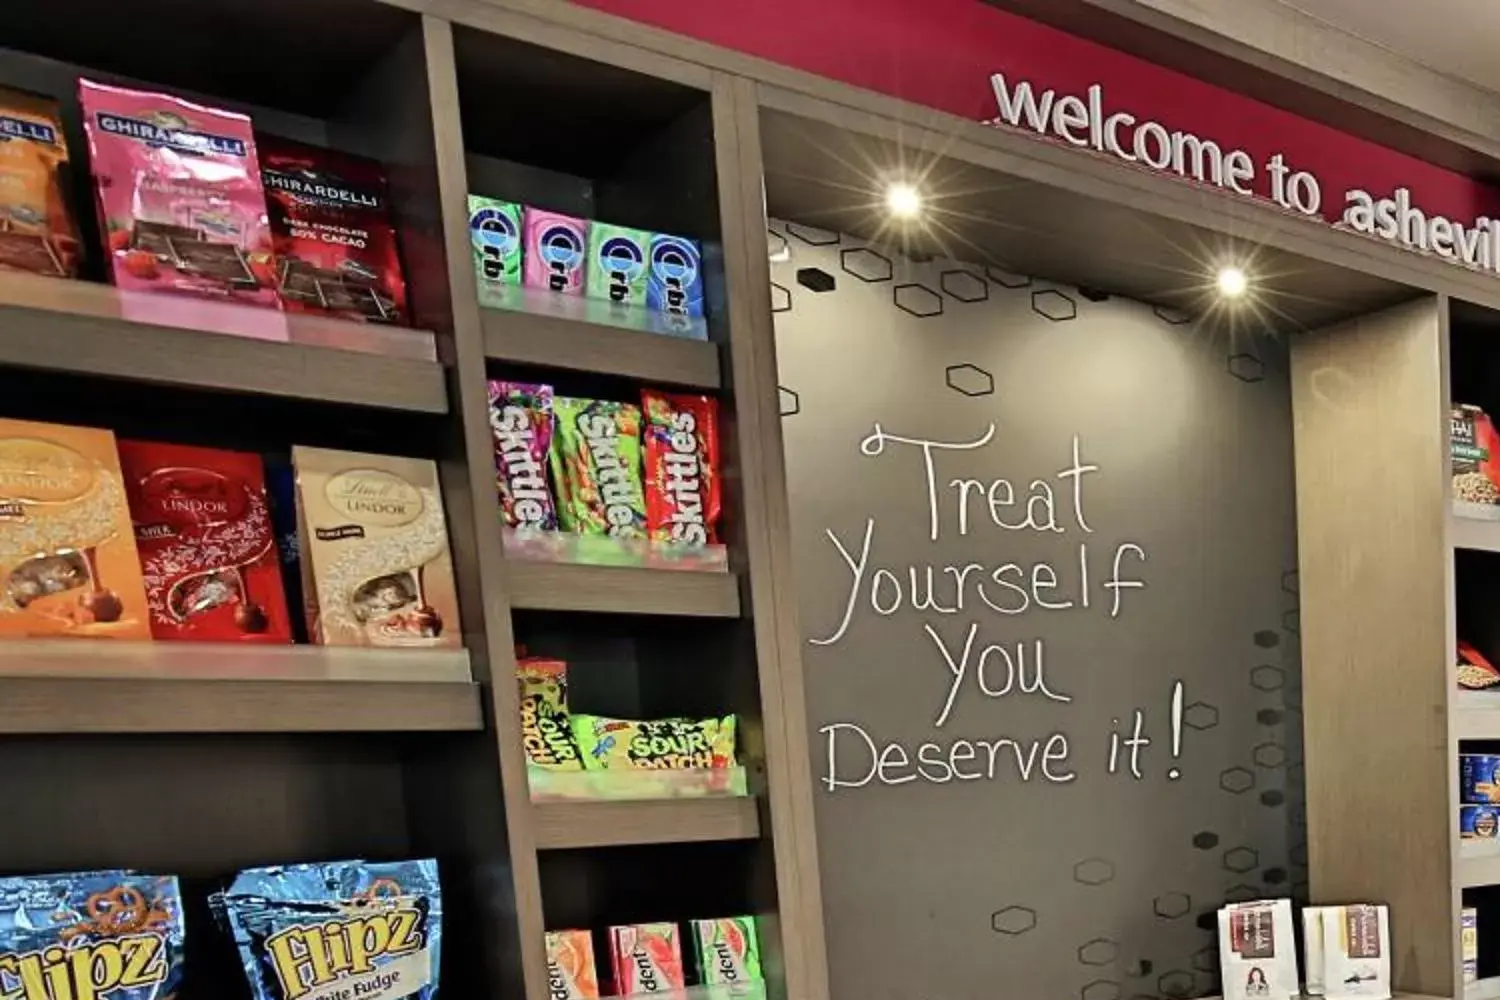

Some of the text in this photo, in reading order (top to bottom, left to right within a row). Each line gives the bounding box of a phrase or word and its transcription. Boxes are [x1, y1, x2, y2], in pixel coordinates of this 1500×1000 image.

[100, 116, 242, 154] GHIRAELLI
[990, 73, 1254, 196] welcome
[1266, 152, 1322, 216] to
[264, 175, 378, 208] HIRARDELLI
[320, 232, 367, 249] CACAO
[861, 423, 1100, 541] Treat
[161, 498, 229, 514] LINDOR
[344, 501, 407, 516] LINDOR
[519, 697, 555, 766] PATCH
[538, 700, 576, 761] SOUR
[632, 732, 708, 757] SOUR
[818, 722, 1077, 792] Deserve
[353, 968, 401, 997] Fudge
